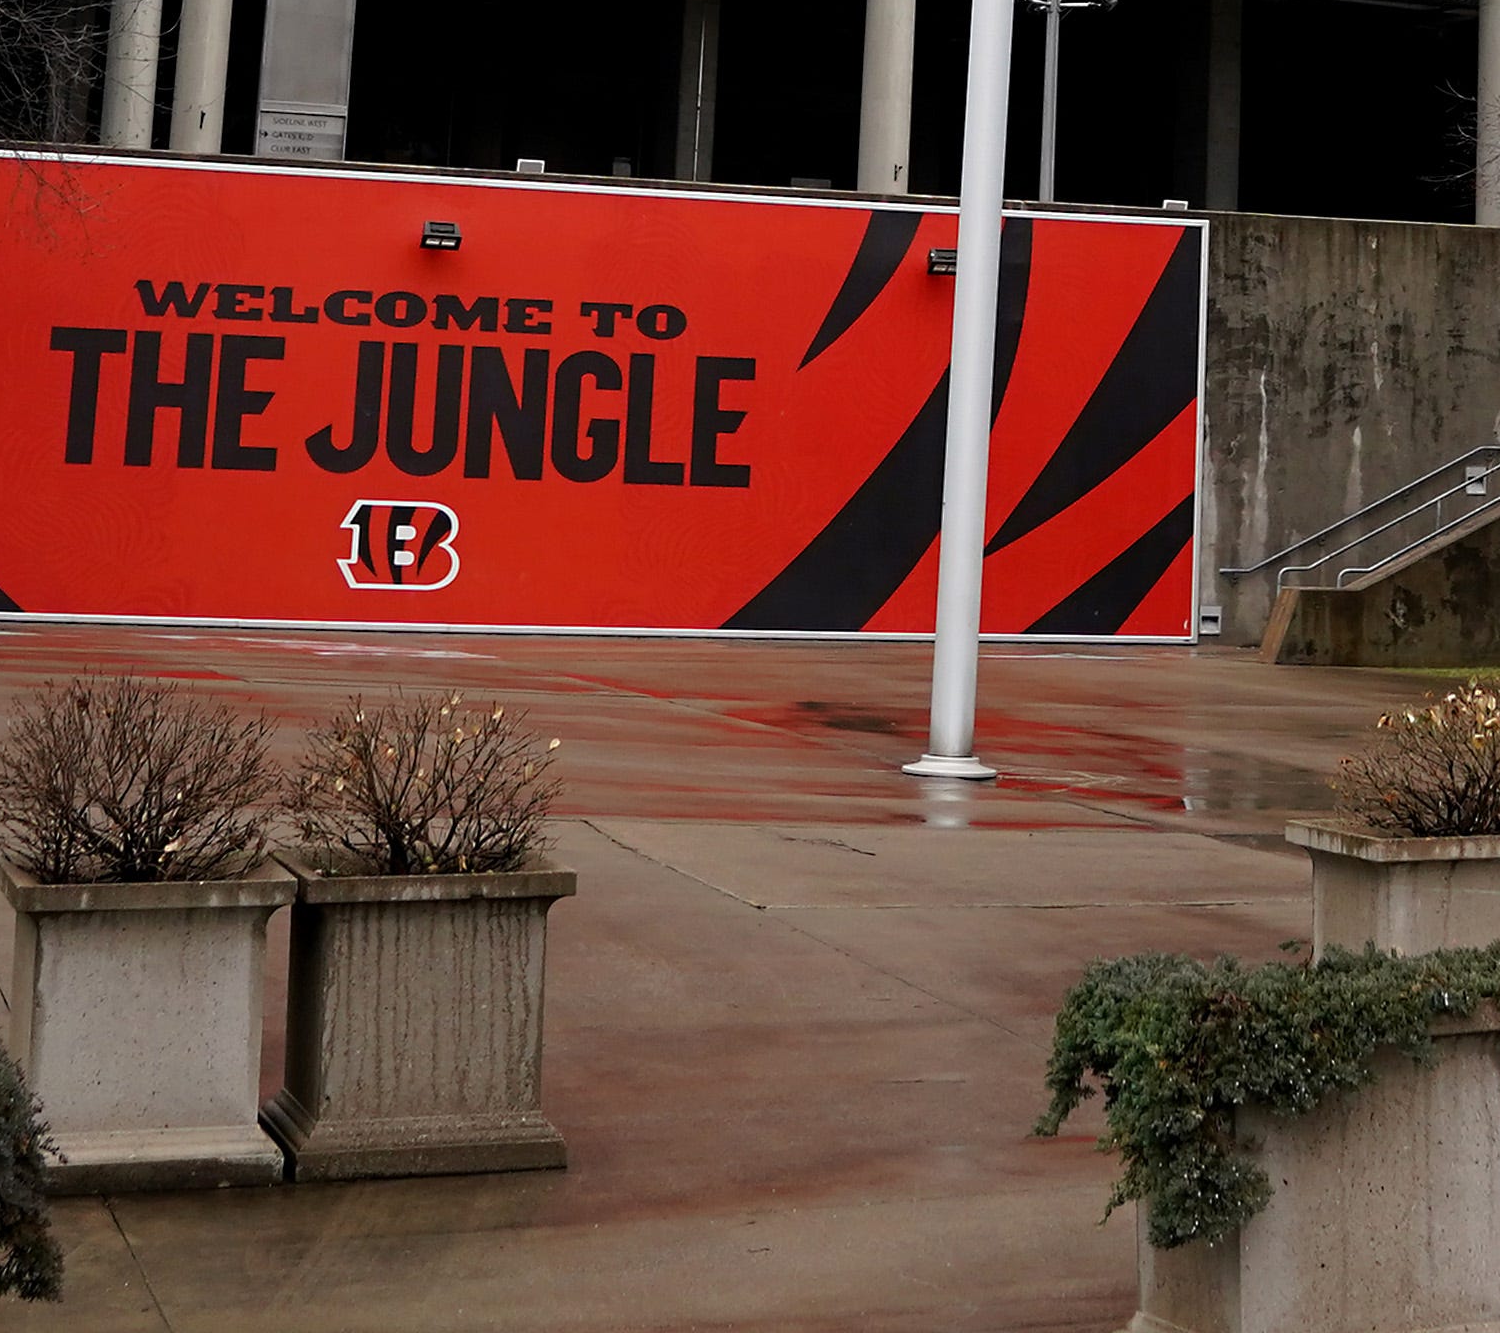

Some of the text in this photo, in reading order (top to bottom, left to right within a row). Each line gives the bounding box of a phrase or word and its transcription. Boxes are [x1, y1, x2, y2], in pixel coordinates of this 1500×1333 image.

[133, 279, 688, 341] WELCOME TO
[49, 325, 757, 489] THE JUNGLE
